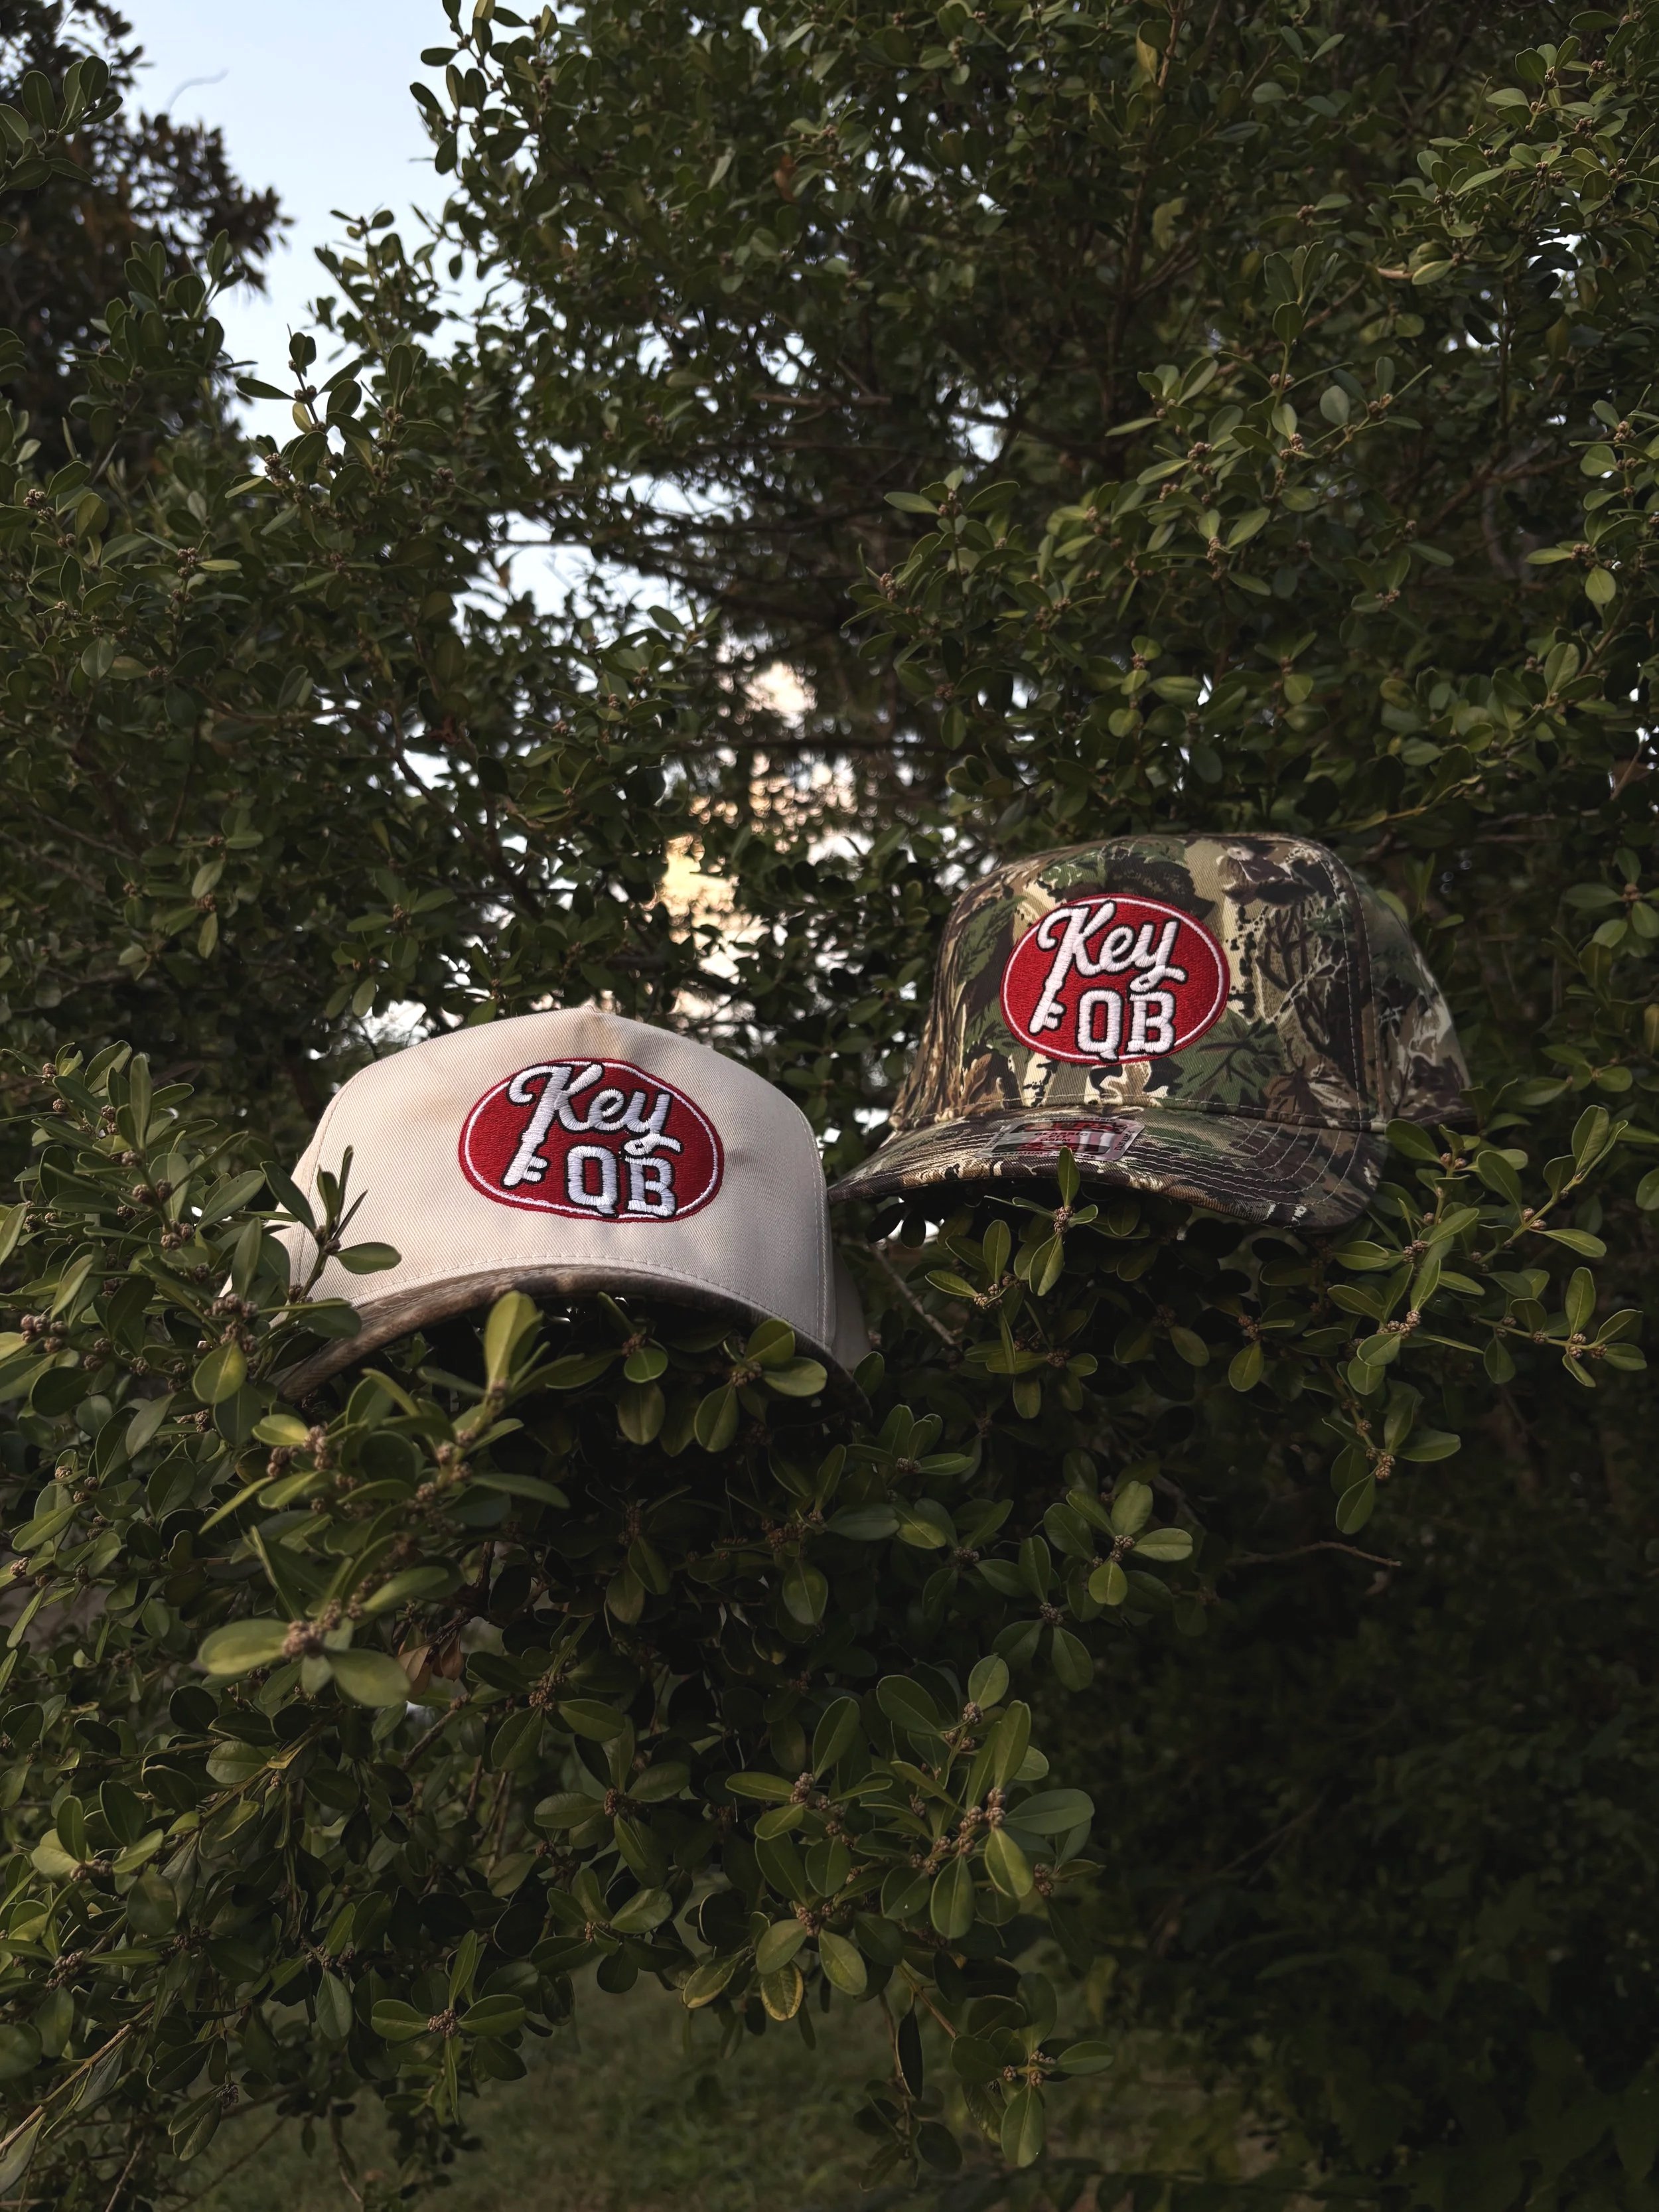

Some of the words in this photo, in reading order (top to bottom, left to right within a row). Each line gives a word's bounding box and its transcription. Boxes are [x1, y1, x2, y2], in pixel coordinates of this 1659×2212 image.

[1029, 899, 1187, 1035] Key
[1076, 989, 1176, 1063] QB
[502, 1063, 682, 1188] Key
[564, 1144, 678, 1217] QB
